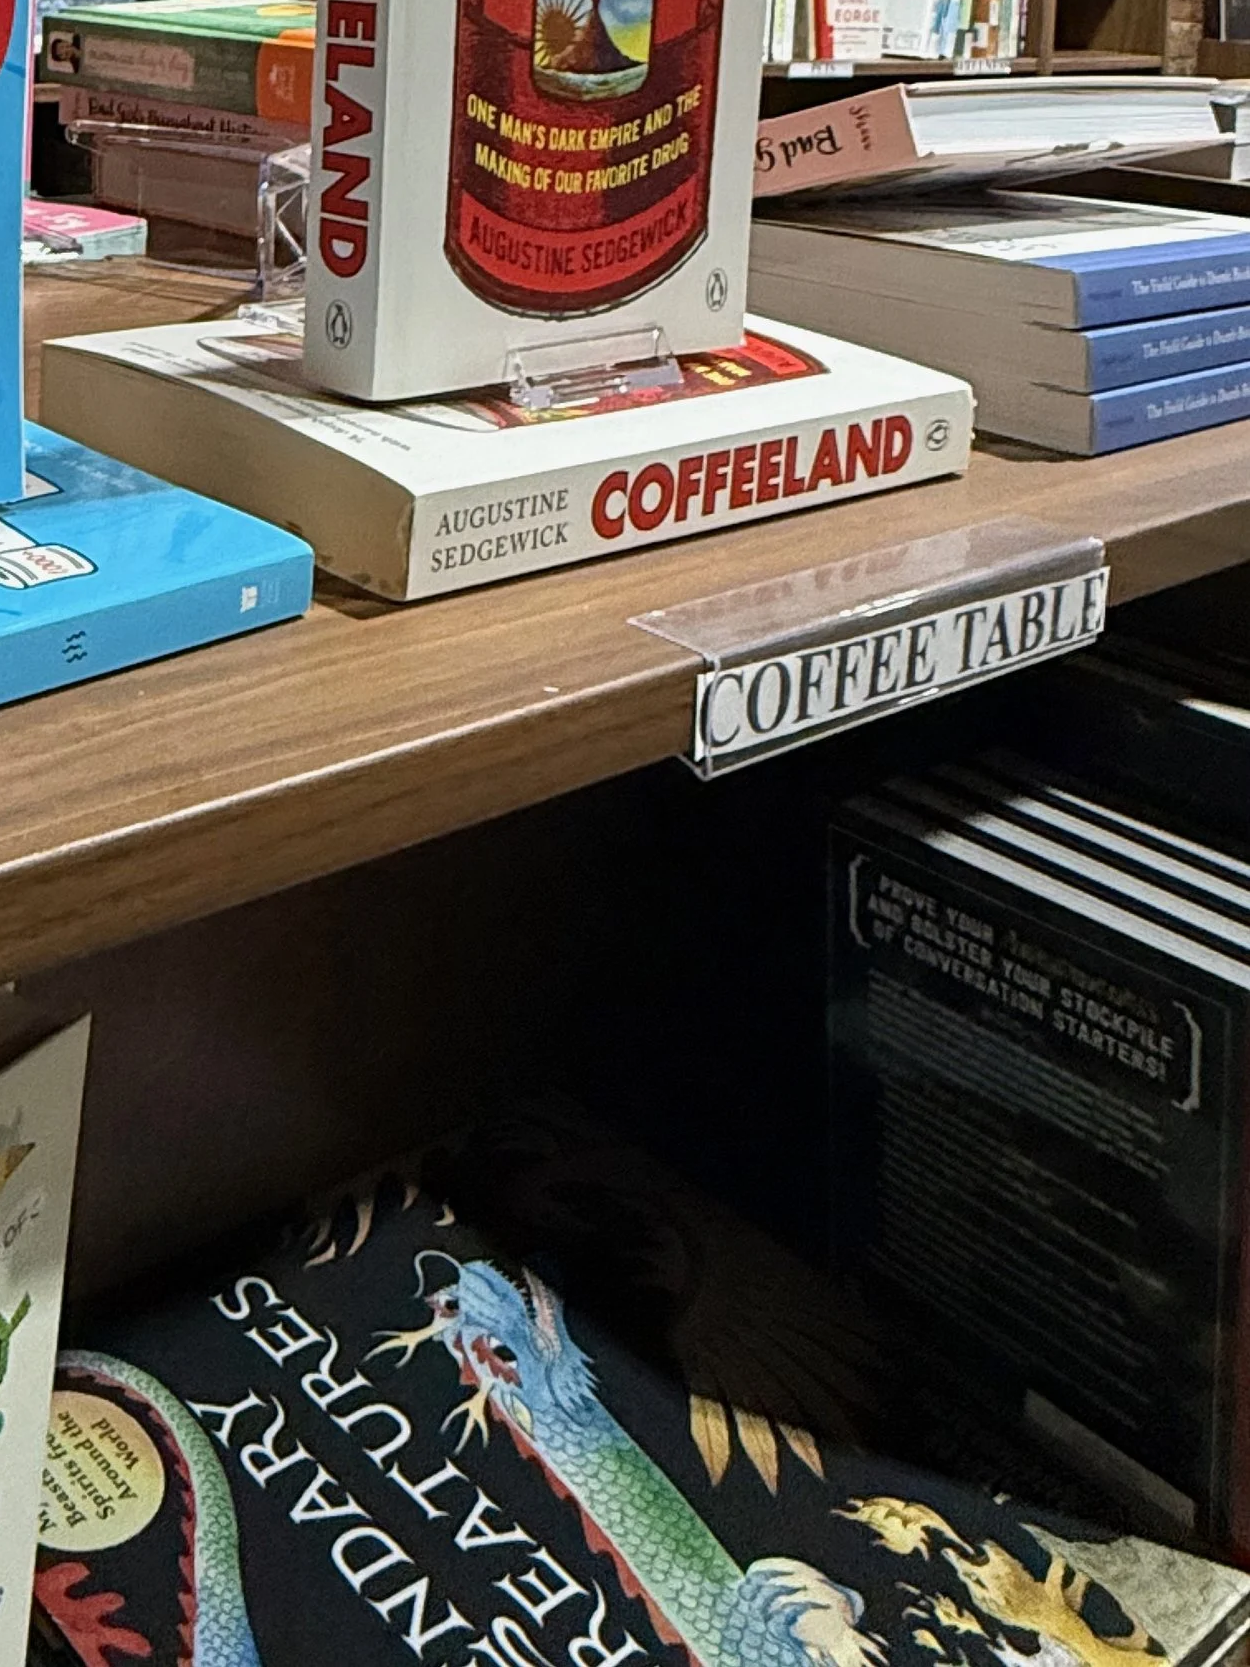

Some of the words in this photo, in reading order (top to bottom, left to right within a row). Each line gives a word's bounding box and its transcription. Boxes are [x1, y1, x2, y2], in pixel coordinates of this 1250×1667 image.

[466, 92, 497, 130] ONE
[499, 112, 547, 151] MAN'S
[548, 127, 588, 152] DARK
[587, 117, 642, 152] EMPIRE
[642, 102, 674, 136] AND
[675, 83, 704, 119] THE
[780, 125, 843, 169] Bad
[474, 141, 533, 190] MAKING
[533, 166, 553, 191] OF
[553, 168, 584, 195] OUR
[584, 156, 650, 194] FAVORITE
[651, 132, 691, 171] DRUG
[466, 215, 577, 278] AUGUSTINE
[580, 197, 689, 274] SEDGEWICK
[433, 487, 571, 539] AUGUSTINE
[590, 413, 915, 541] COFFEELAND
[430, 520, 571, 574] SEDGEWICK
[699, 618, 940, 749] COFFEE
[952, 570, 1108, 675] TABLE
[866, 892, 905, 926] AND
[910, 912, 993, 972] BOLSTER
[1059, 987, 1176, 1062] STOCKPILE
[902, 936, 1045, 1021] CONVERSATION
[1051, 1010, 1168, 1084] STARTERS!
[56, 1409, 84, 1438] the
[90, 1416, 140, 1472] World
[62, 1458, 117, 1521] Spirits
[73, 1437, 139, 1501] Around
